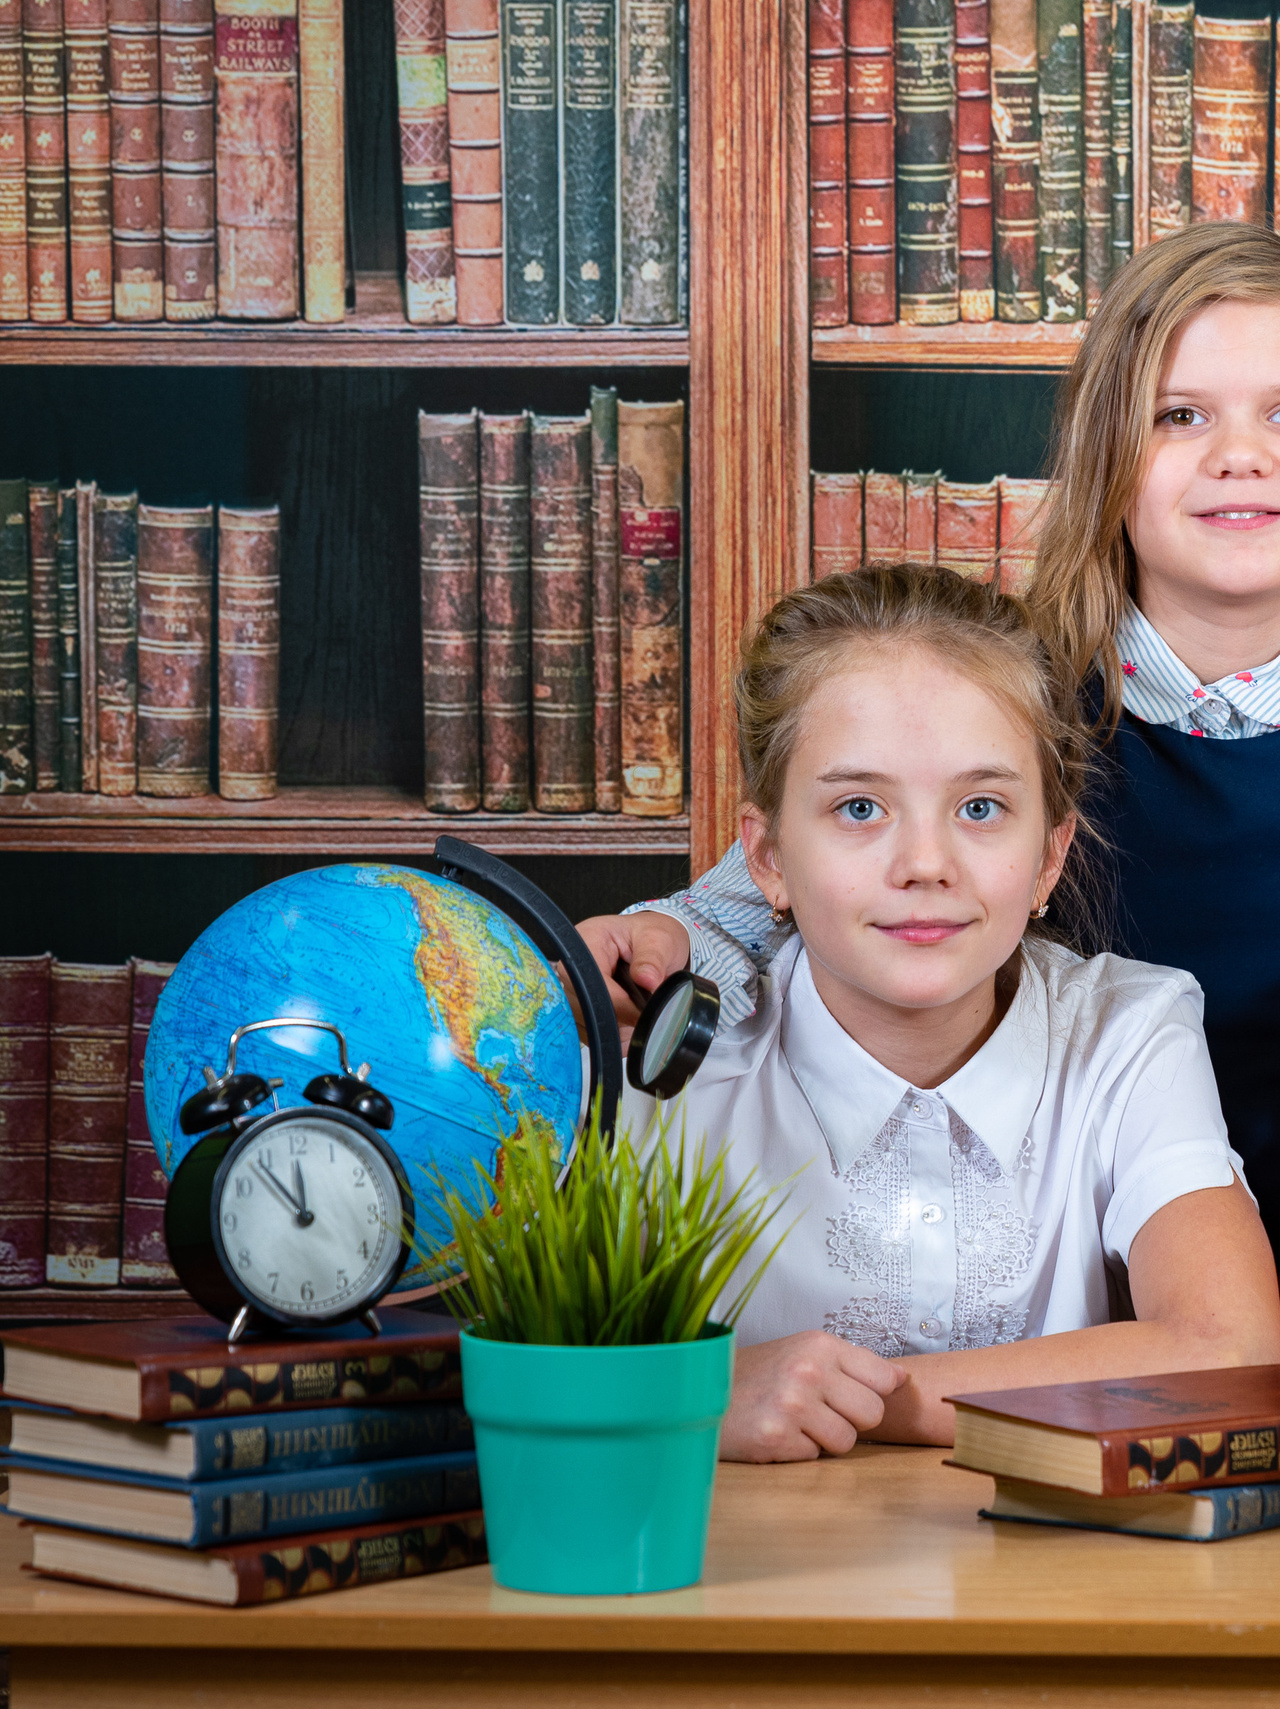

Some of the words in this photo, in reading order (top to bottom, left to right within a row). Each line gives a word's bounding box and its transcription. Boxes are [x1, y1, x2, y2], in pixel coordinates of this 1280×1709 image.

[230, 17, 280, 31] BOOTH
[227, 38, 285, 54] STREET
[219, 56, 292, 72] RAILWAYS
[83, 1117, 94, 1129] 3
[289, 1133, 307, 1155] 12
[329, 1142, 335, 1163] 1
[236, 1176, 254, 1198] 10
[353, 1166, 365, 1188] 2
[224, 1212, 237, 1234] 9
[367, 1203, 380, 1225] 3
[238, 1250, 251, 1270] 8
[357, 1240, 370, 1260] 4
[267, 1272, 280, 1294] 7
[336, 1269, 349, 1291] 5
[301, 1281, 315, 1302] 6
[345, 1361, 367, 1377] 3
[1229, 1430, 1276, 1451] КУПЕР
